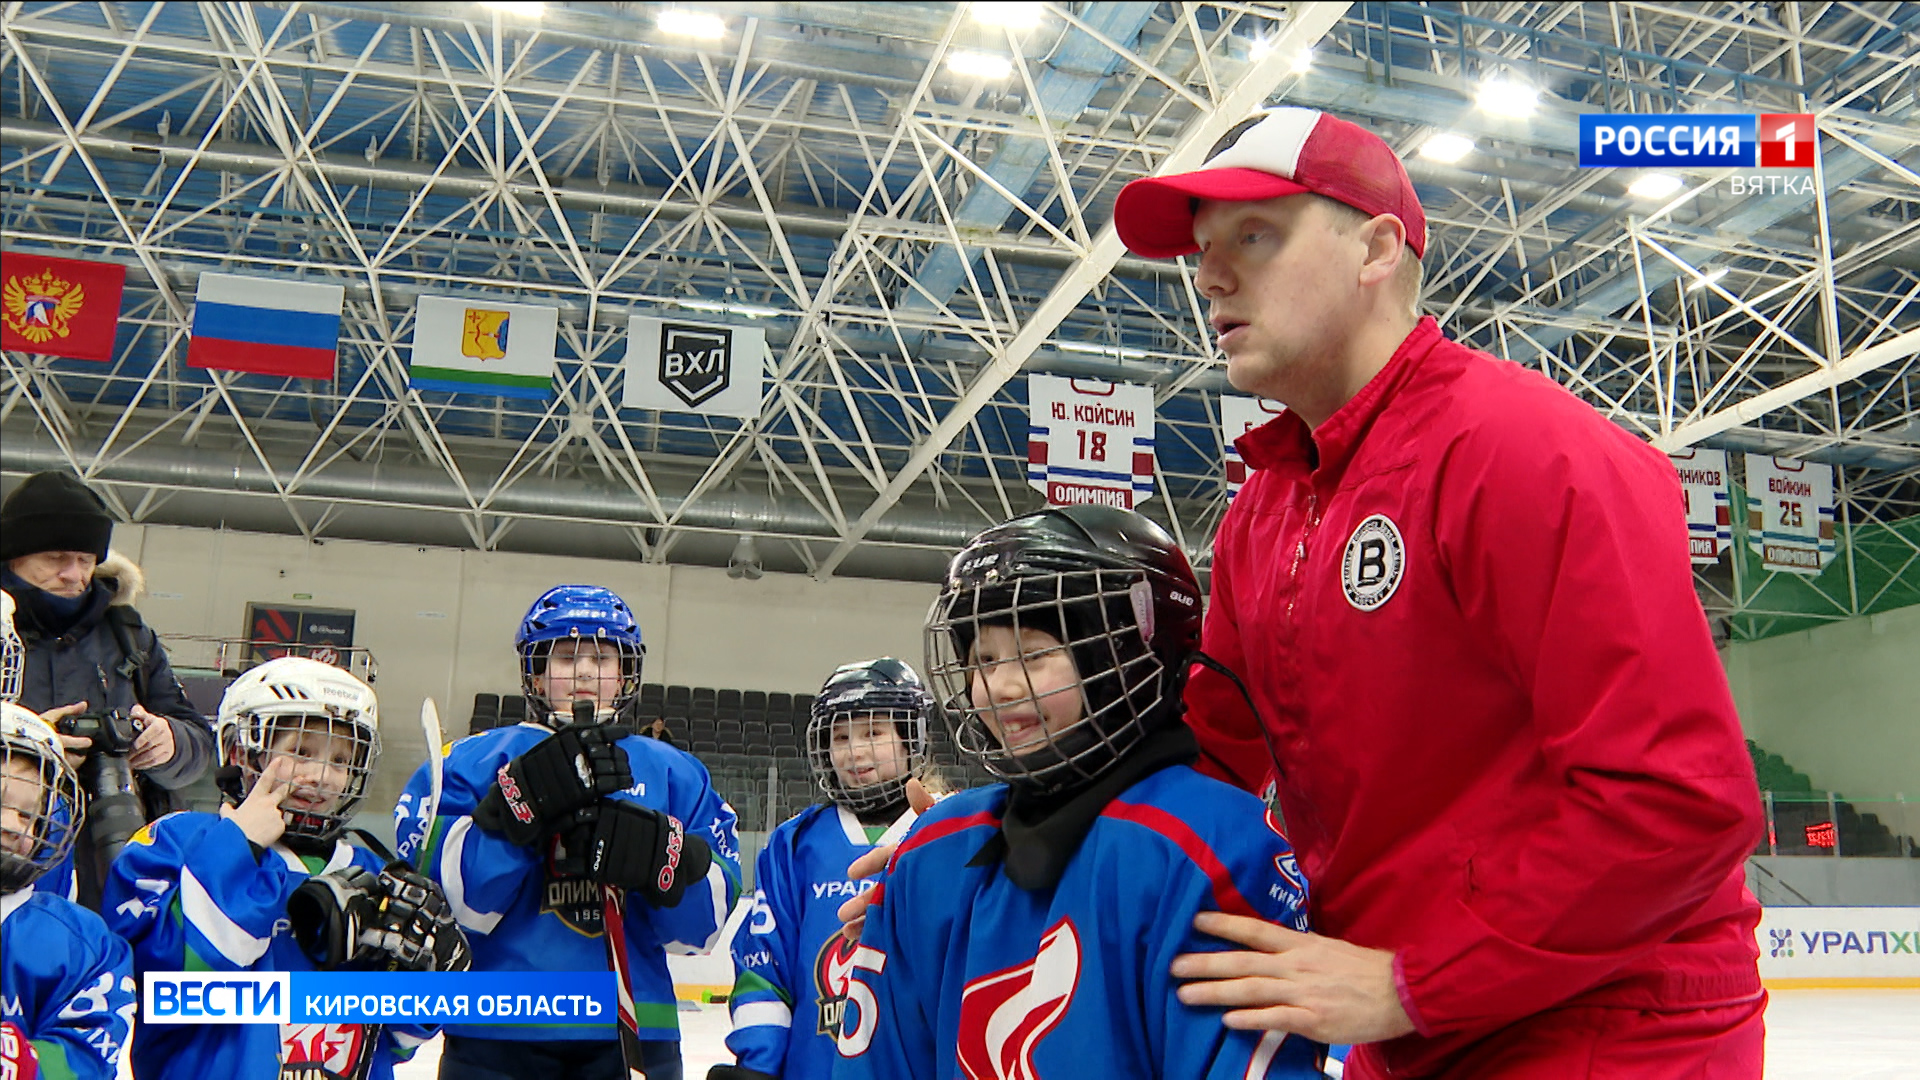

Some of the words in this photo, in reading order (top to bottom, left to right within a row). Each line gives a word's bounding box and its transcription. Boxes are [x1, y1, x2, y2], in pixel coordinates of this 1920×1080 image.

[665, 348, 725, 378] ВХЛ
[1074, 402, 1135, 428] КОЙСИН
[1076, 429, 1107, 461] 18
[1055, 485, 1126, 508] ОЛИМПИЯ
[1769, 476, 1811, 497] ВОЙКИН
[1779, 501, 1803, 527] 25
[1768, 547, 1818, 566] ОЛИМПИЯ
